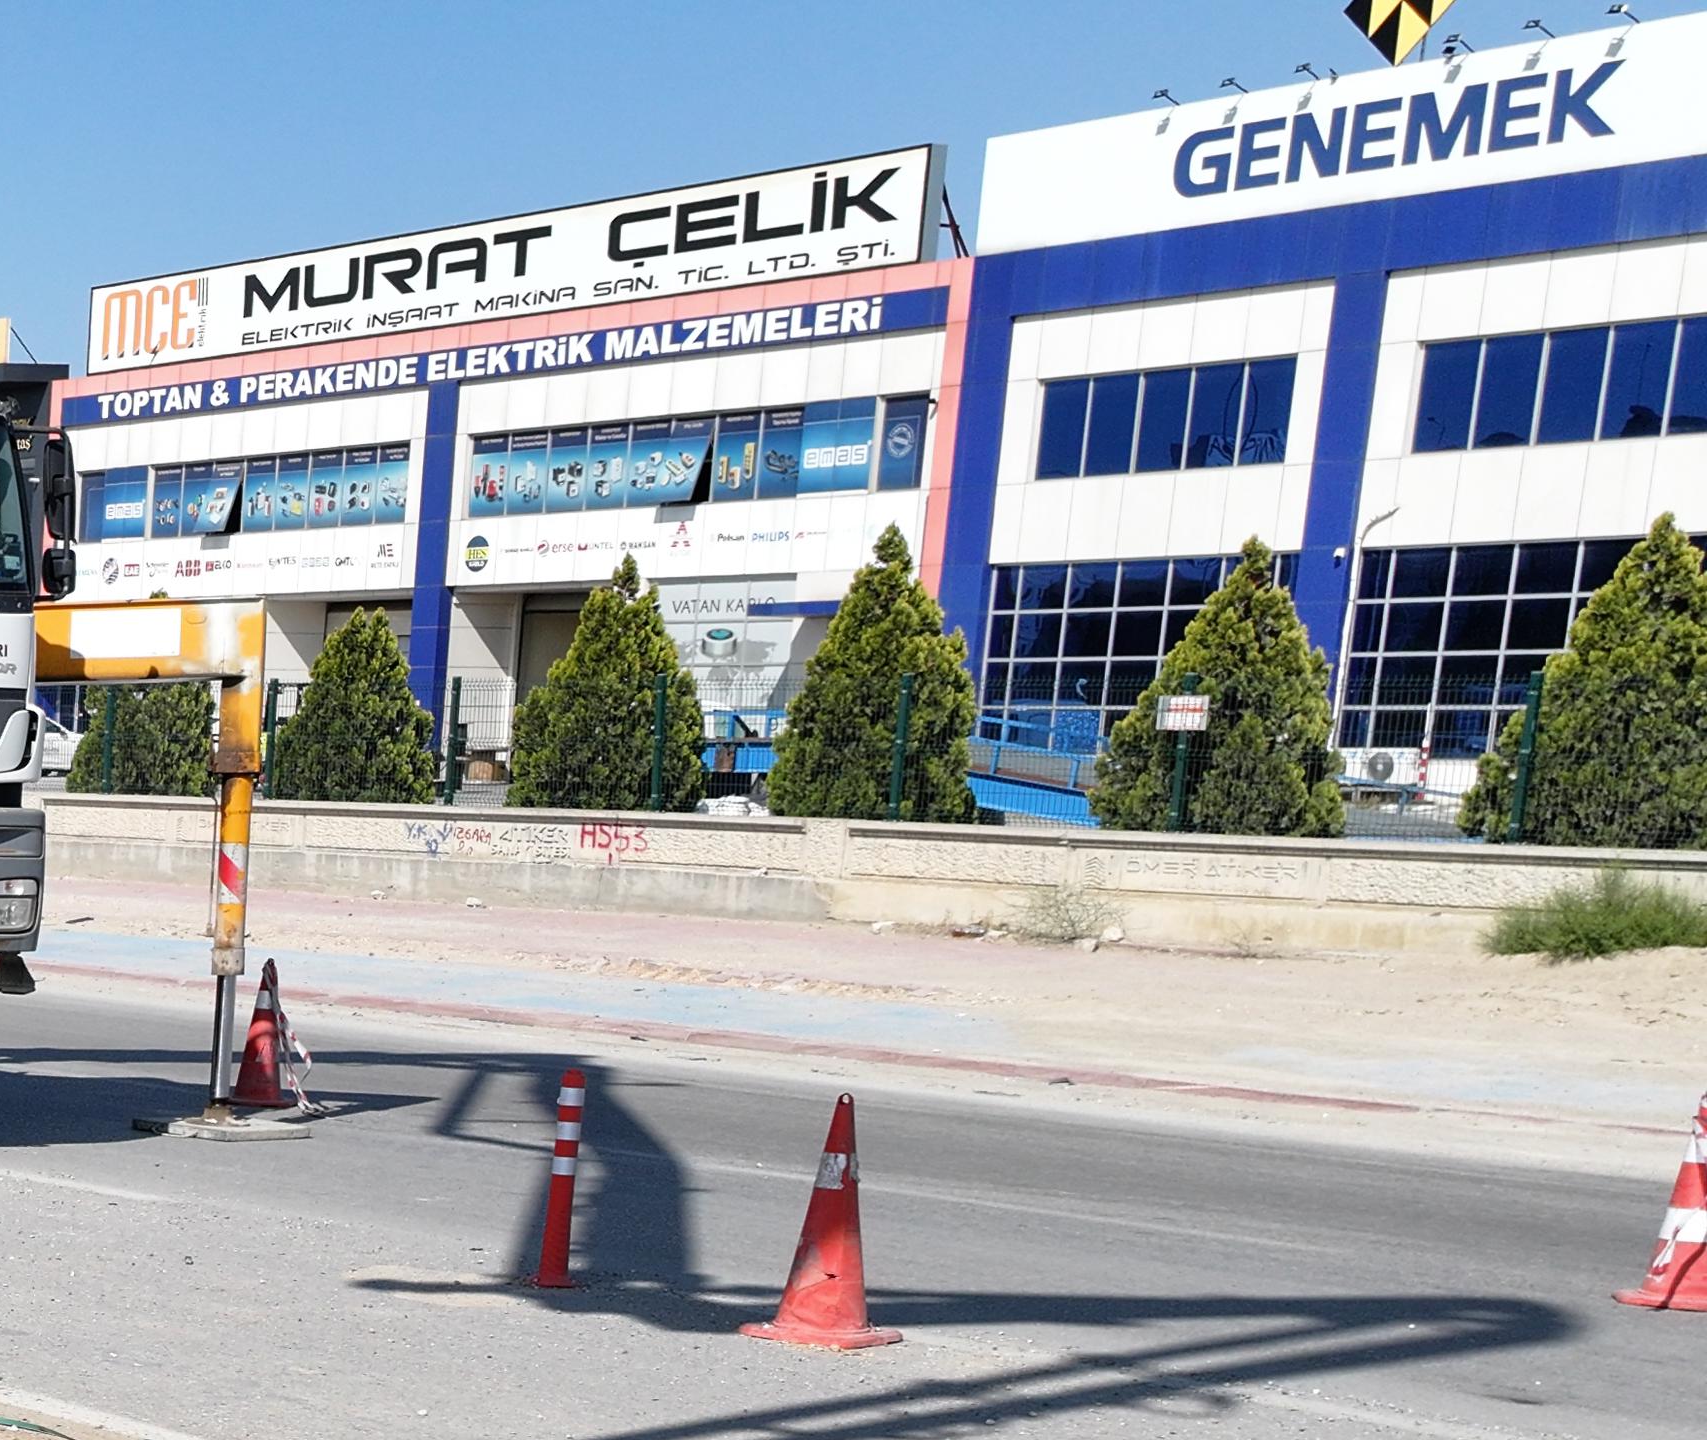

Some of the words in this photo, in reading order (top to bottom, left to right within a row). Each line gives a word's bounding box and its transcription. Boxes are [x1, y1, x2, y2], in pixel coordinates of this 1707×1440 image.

[1173, 58, 1627, 198] GENEMEK
[242, 225, 552, 319] MURAT
[608, 166, 902, 269] ÇELİK
[241, 317, 354, 345] ELEKTRİK
[366, 302, 459, 329] İNŞAAT
[474, 285, 576, 313] MAKİNA
[593, 273, 659, 298] SAN.
[678, 264, 728, 285] TİC.
[747, 252, 816, 277] LTD.
[837, 239, 895, 266] ŞTİ.
[98, 382, 200, 420] TOPTAN
[209, 379, 230, 407] &
[240, 356, 418, 402] PERAKENDE
[426, 333, 593, 383] ELEKTRİK
[604, 297, 883, 361] MALZEMELERİ
[551, 542, 575, 553] erse
[751, 531, 790, 542] PHILIPS
[175, 559, 201, 578] ABB
[672, 599, 721, 614] VATAN
